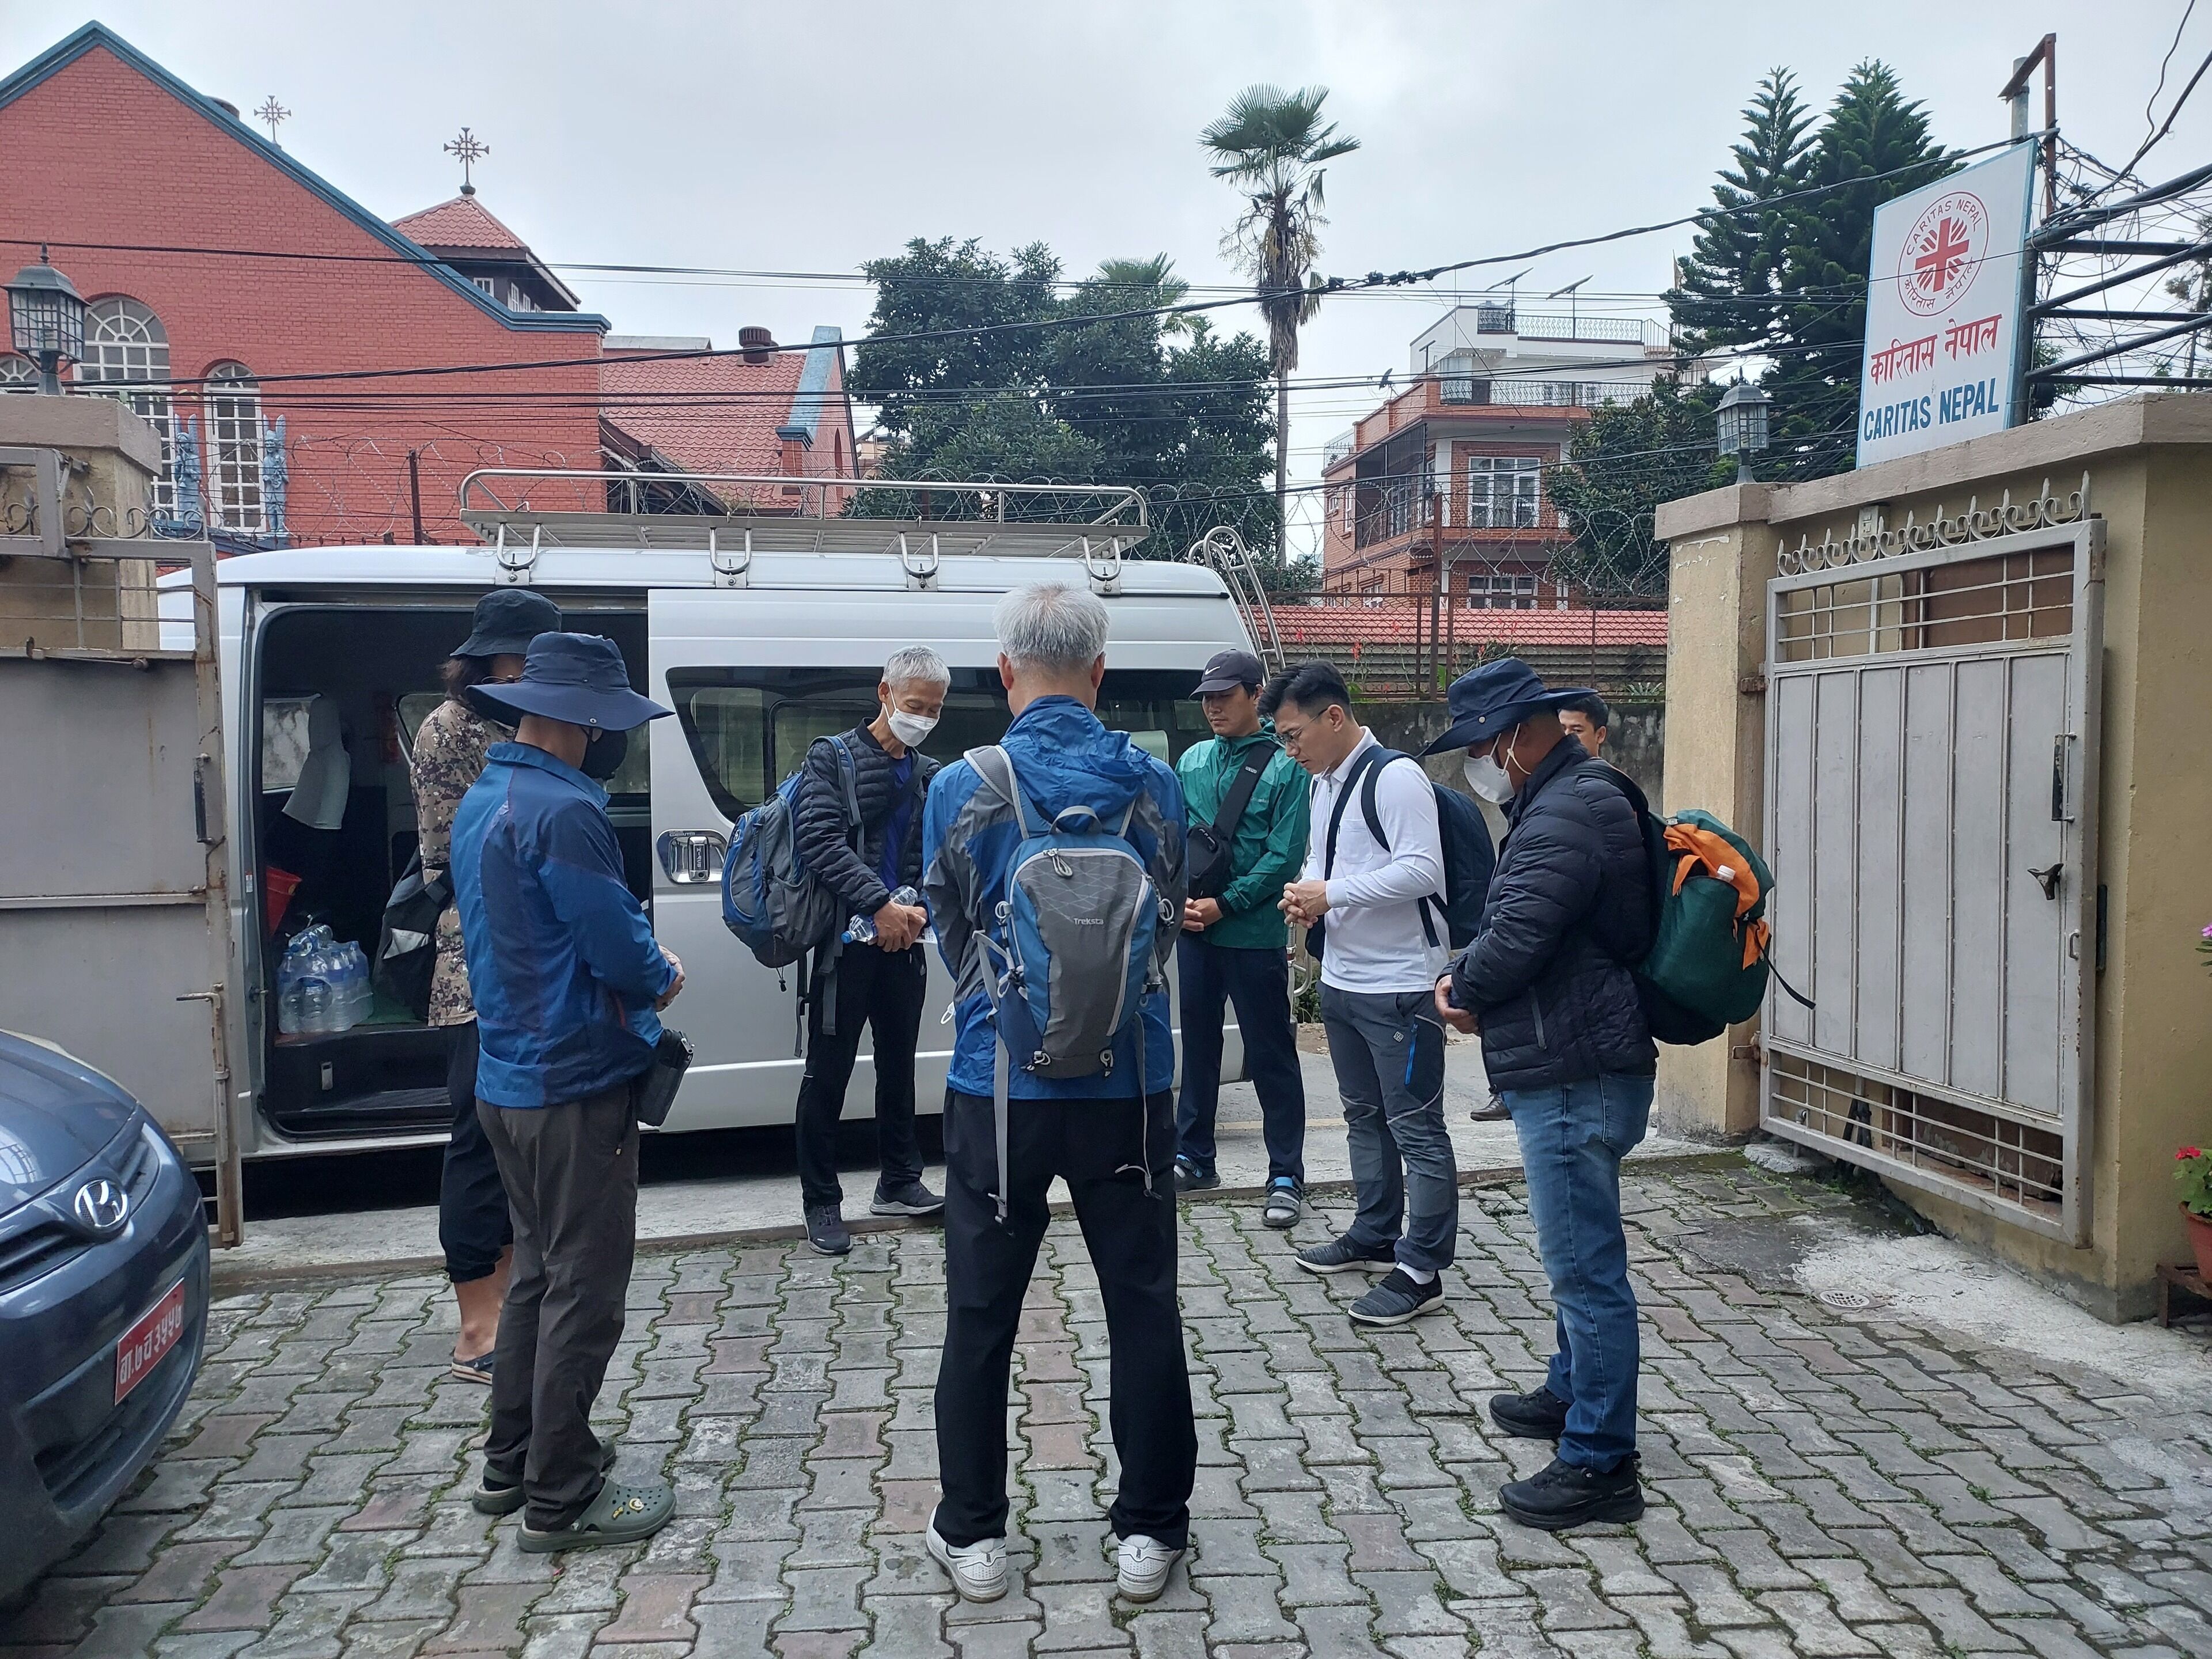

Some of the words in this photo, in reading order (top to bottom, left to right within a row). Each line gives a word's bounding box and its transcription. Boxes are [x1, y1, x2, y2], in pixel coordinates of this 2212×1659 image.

[1907, 200, 1952, 255] CARITAS
[1956, 199, 1982, 232] NEPAL
[1870, 334, 1938, 387] कारितास
[1944, 314, 2002, 361] नेपाल
[1864, 395, 1931, 441] CARITAS
[1939, 378, 1999, 425] NEPAL
